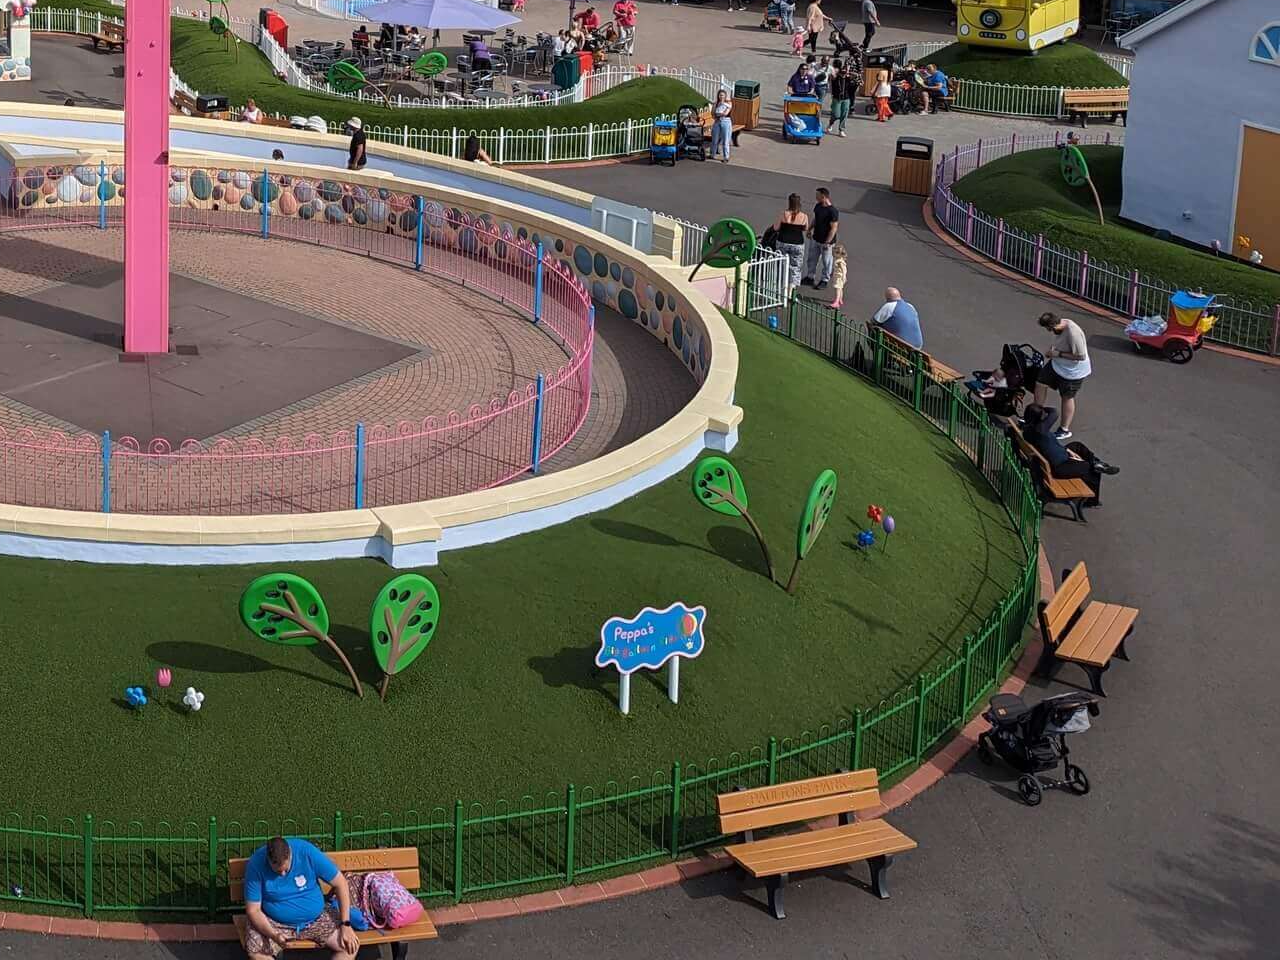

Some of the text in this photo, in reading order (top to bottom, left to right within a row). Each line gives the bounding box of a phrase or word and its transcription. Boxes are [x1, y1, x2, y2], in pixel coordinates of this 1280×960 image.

[614, 621, 655, 644] Peppa's
[815, 777, 848, 793] PARK
[344, 854, 382, 867] PARK
